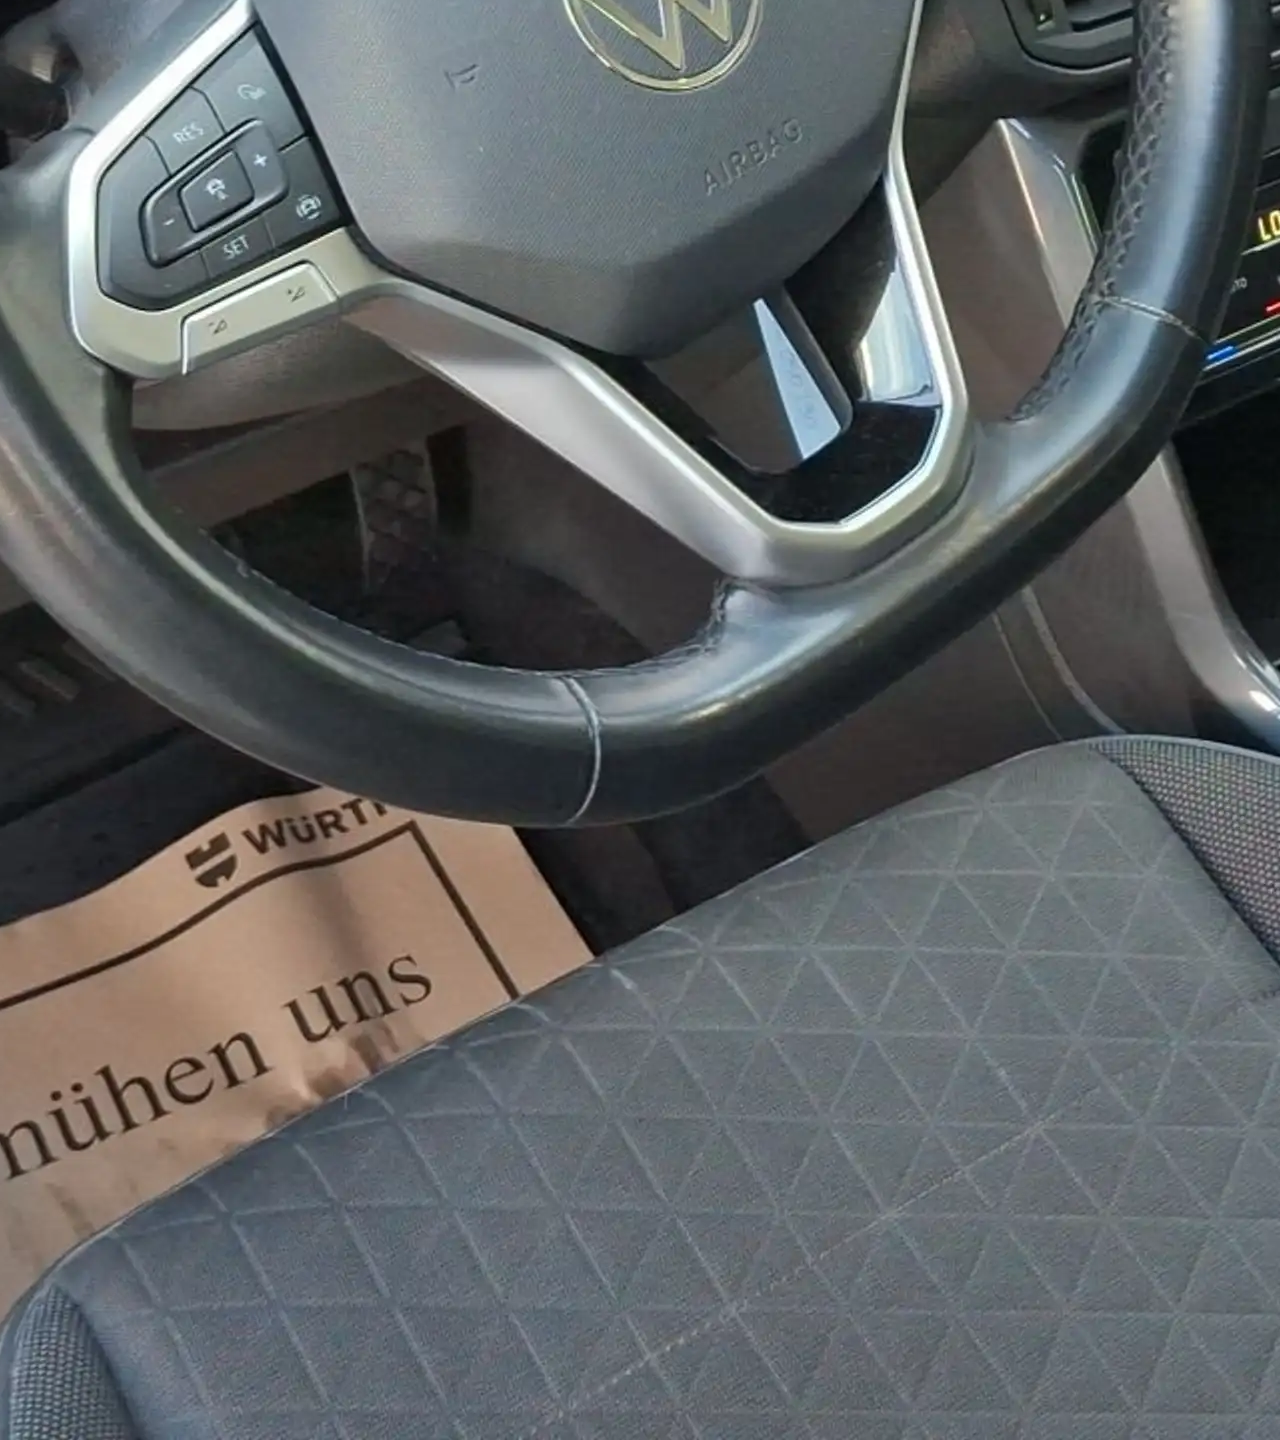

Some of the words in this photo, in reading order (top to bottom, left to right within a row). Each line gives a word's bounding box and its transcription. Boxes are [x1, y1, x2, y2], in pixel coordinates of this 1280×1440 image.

[173, 122, 204, 144] RES
[705, 118, 803, 196] AIRBAG
[223, 234, 250, 259] SET
[283, 953, 436, 1044] uns
